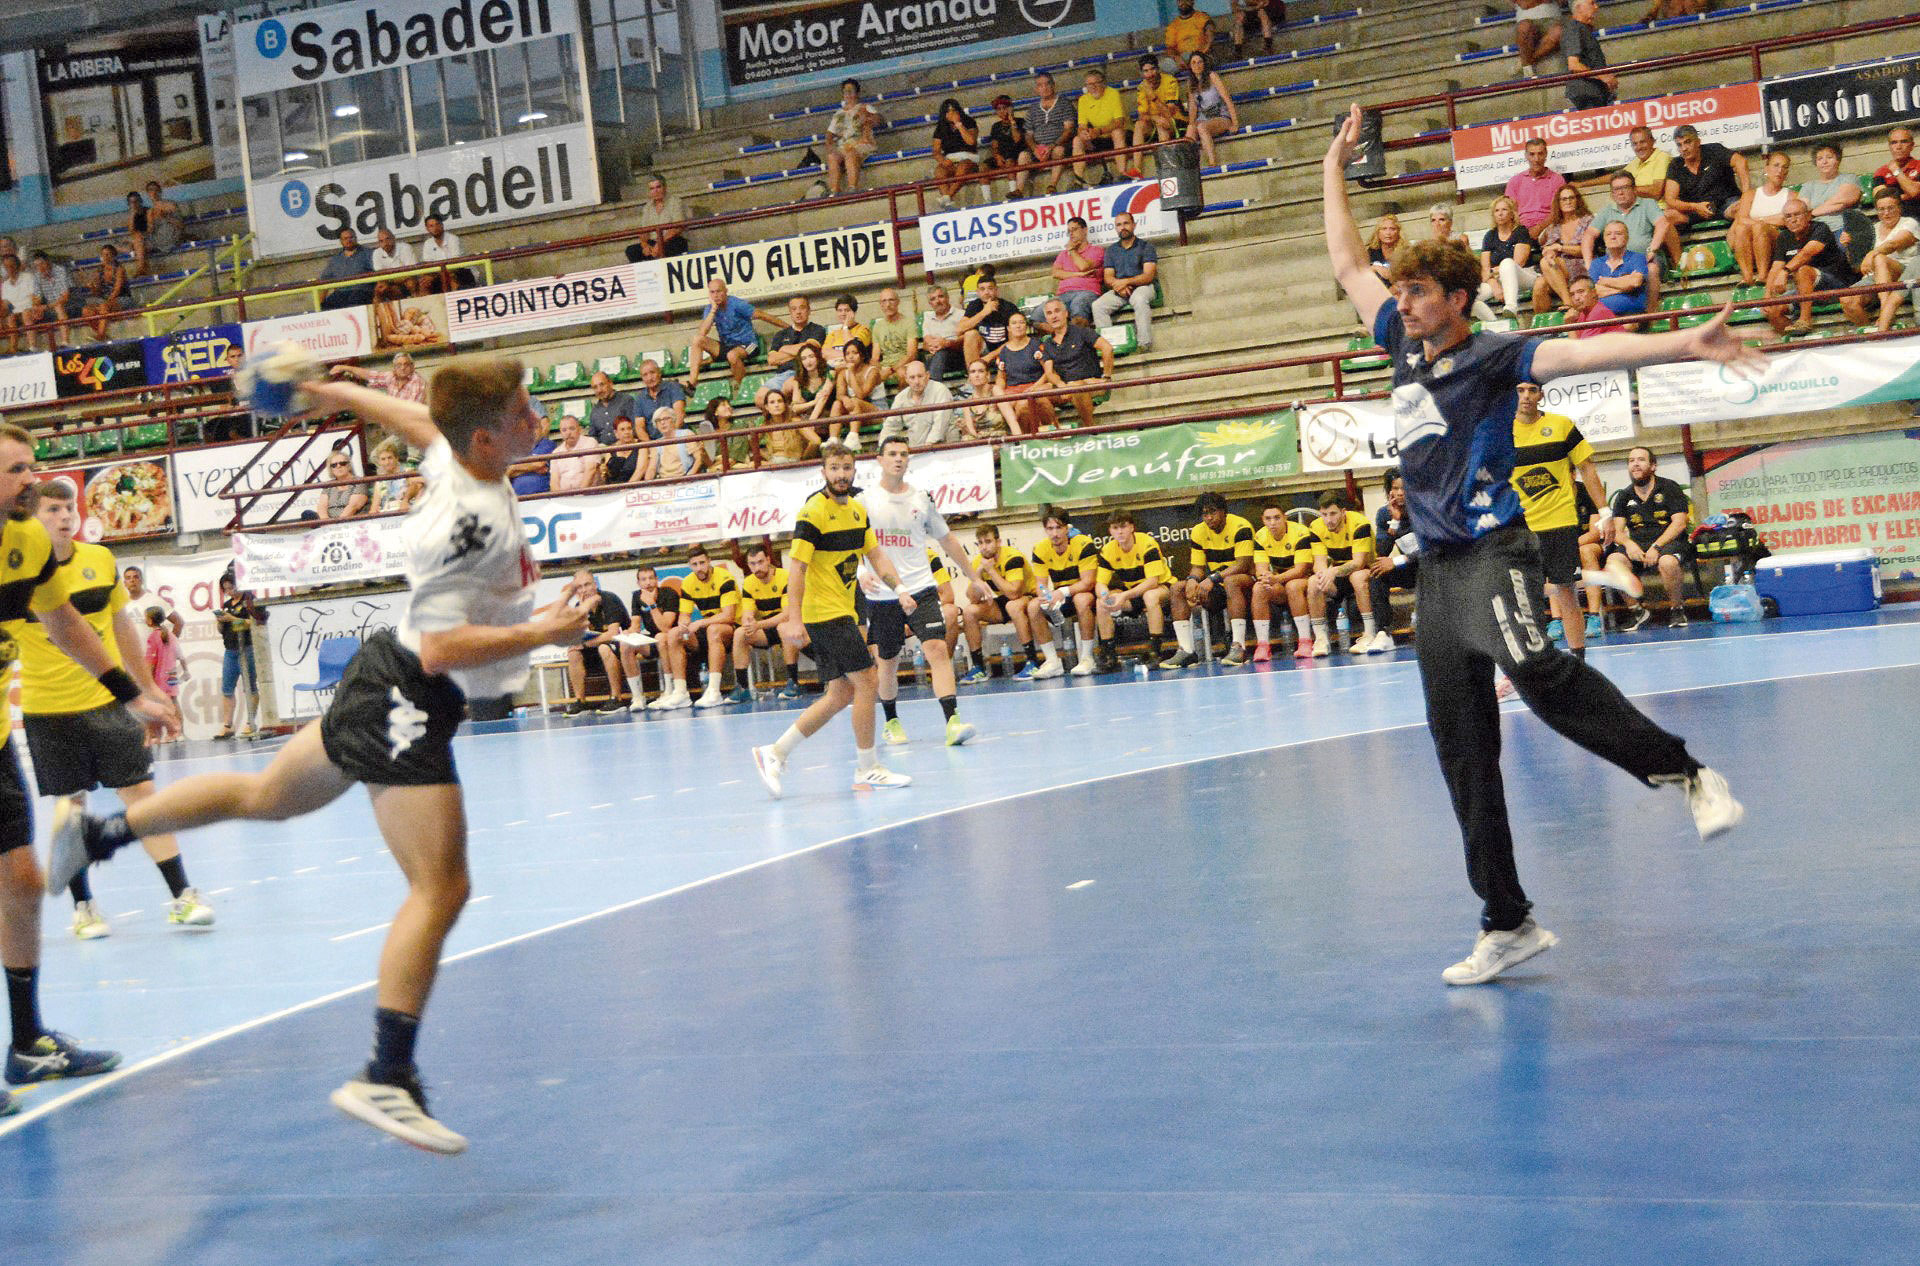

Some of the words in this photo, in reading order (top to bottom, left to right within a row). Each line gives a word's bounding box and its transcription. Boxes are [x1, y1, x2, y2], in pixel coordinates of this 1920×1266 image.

[290, 0, 552, 81] Sabadell
[738, 18, 846, 61] Motor
[856, 0, 998, 39] Aranda
[47, 63, 69, 82] LA
[70, 56, 125, 79] RIBERA
[1644, 97, 1718, 125] DUERO
[1769, 89, 1873, 132] Mesón
[1722, 120, 1760, 135] SEGUROS
[314, 143, 573, 241] Sabadell
[932, 196, 1104, 245] GLASSDRIVE
[933, 245, 949, 258] Tu
[950, 240, 993, 258] experto
[996, 237, 1010, 248] en
[1012, 230, 1044, 246] lunas
[666, 248, 756, 295] NUEVO
[765, 229, 889, 283] ALLENDE
[456, 274, 627, 323] PROINTORSA
[1538, 377, 1622, 409] JOYERÍA
[1009, 432, 1141, 462] Floristerias
[1015, 443, 1256, 495] Nenúfar
[1718, 476, 1761, 492] SERVICIO
[1762, 472, 1789, 487] PARA
[1789, 471, 1817, 485] TODO
[1818, 468, 1841, 481] TIPO
[1842, 466, 1856, 480] DE
[1857, 461, 1920, 478] PRODUCTOS
[727, 505, 788, 532] Mica
[1822, 498, 1846, 519] DE
[875, 528, 914, 548] HEROL
[1866, 521, 1880, 541] Y
[311, 566, 321, 575] El
[321, 561, 364, 574] Arandino
